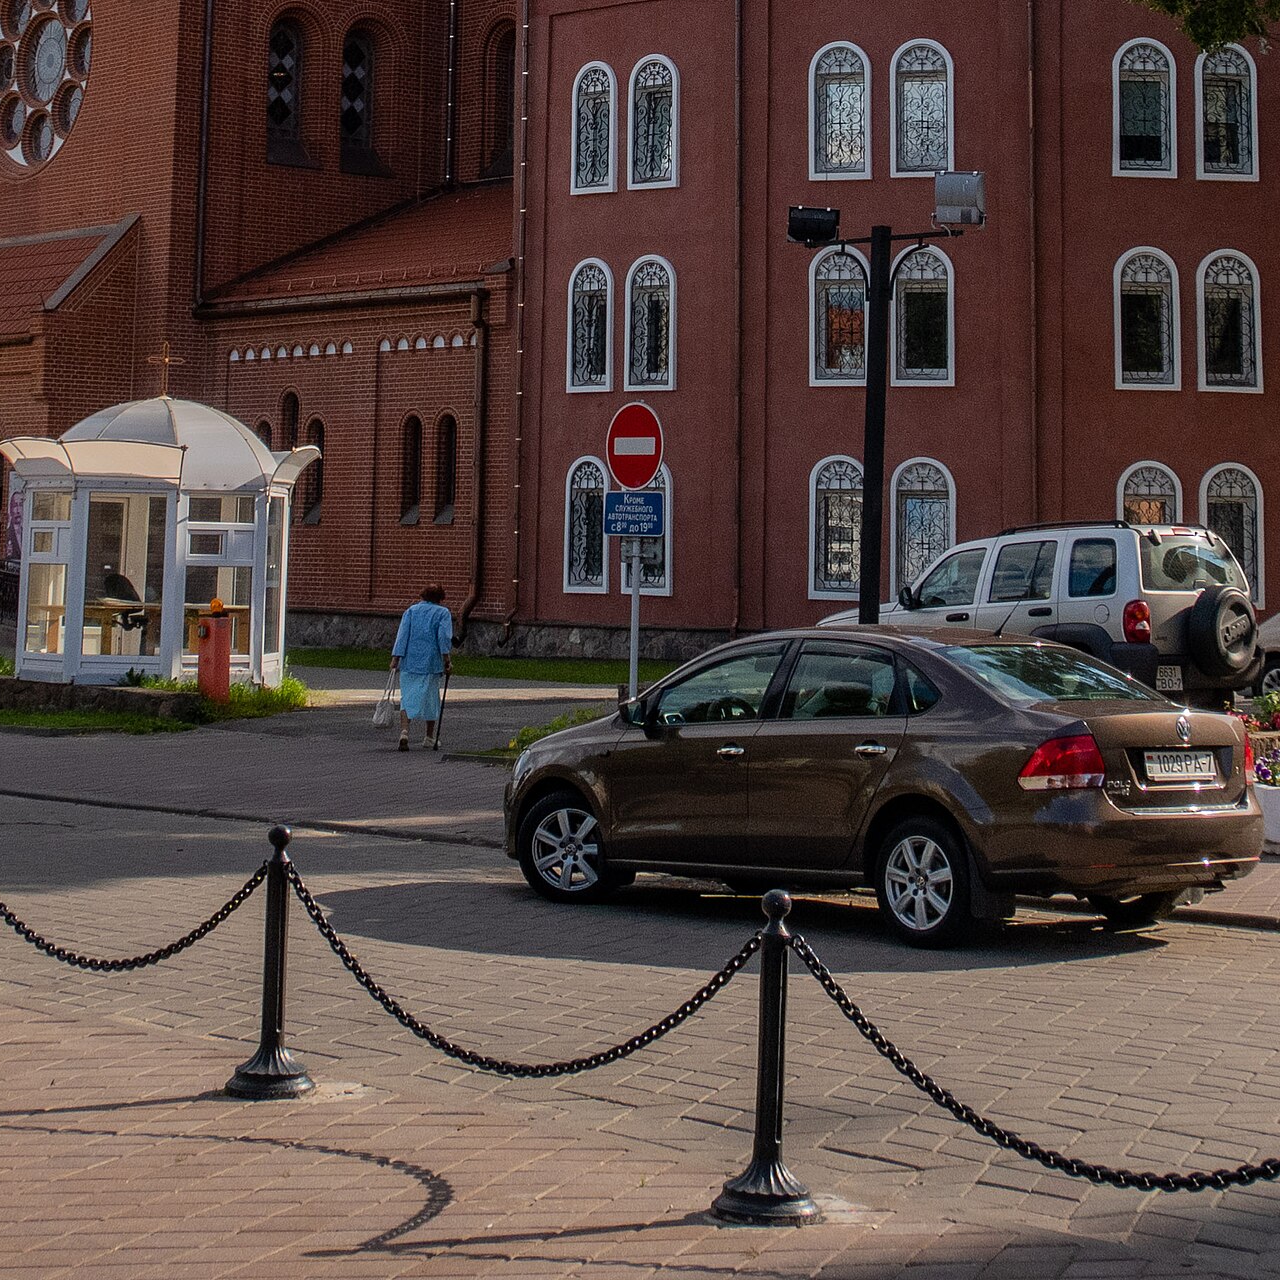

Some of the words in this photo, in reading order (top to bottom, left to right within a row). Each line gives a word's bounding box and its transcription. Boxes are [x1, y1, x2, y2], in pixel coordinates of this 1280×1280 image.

[615, 505, 653, 513] СЛУЖЕБНОГО
[607, 513, 658, 522] АВТОТРАНСПОРТА
[1157, 754, 1184, 773] 1029
[1184, 753, 1212, 773] PA-7
